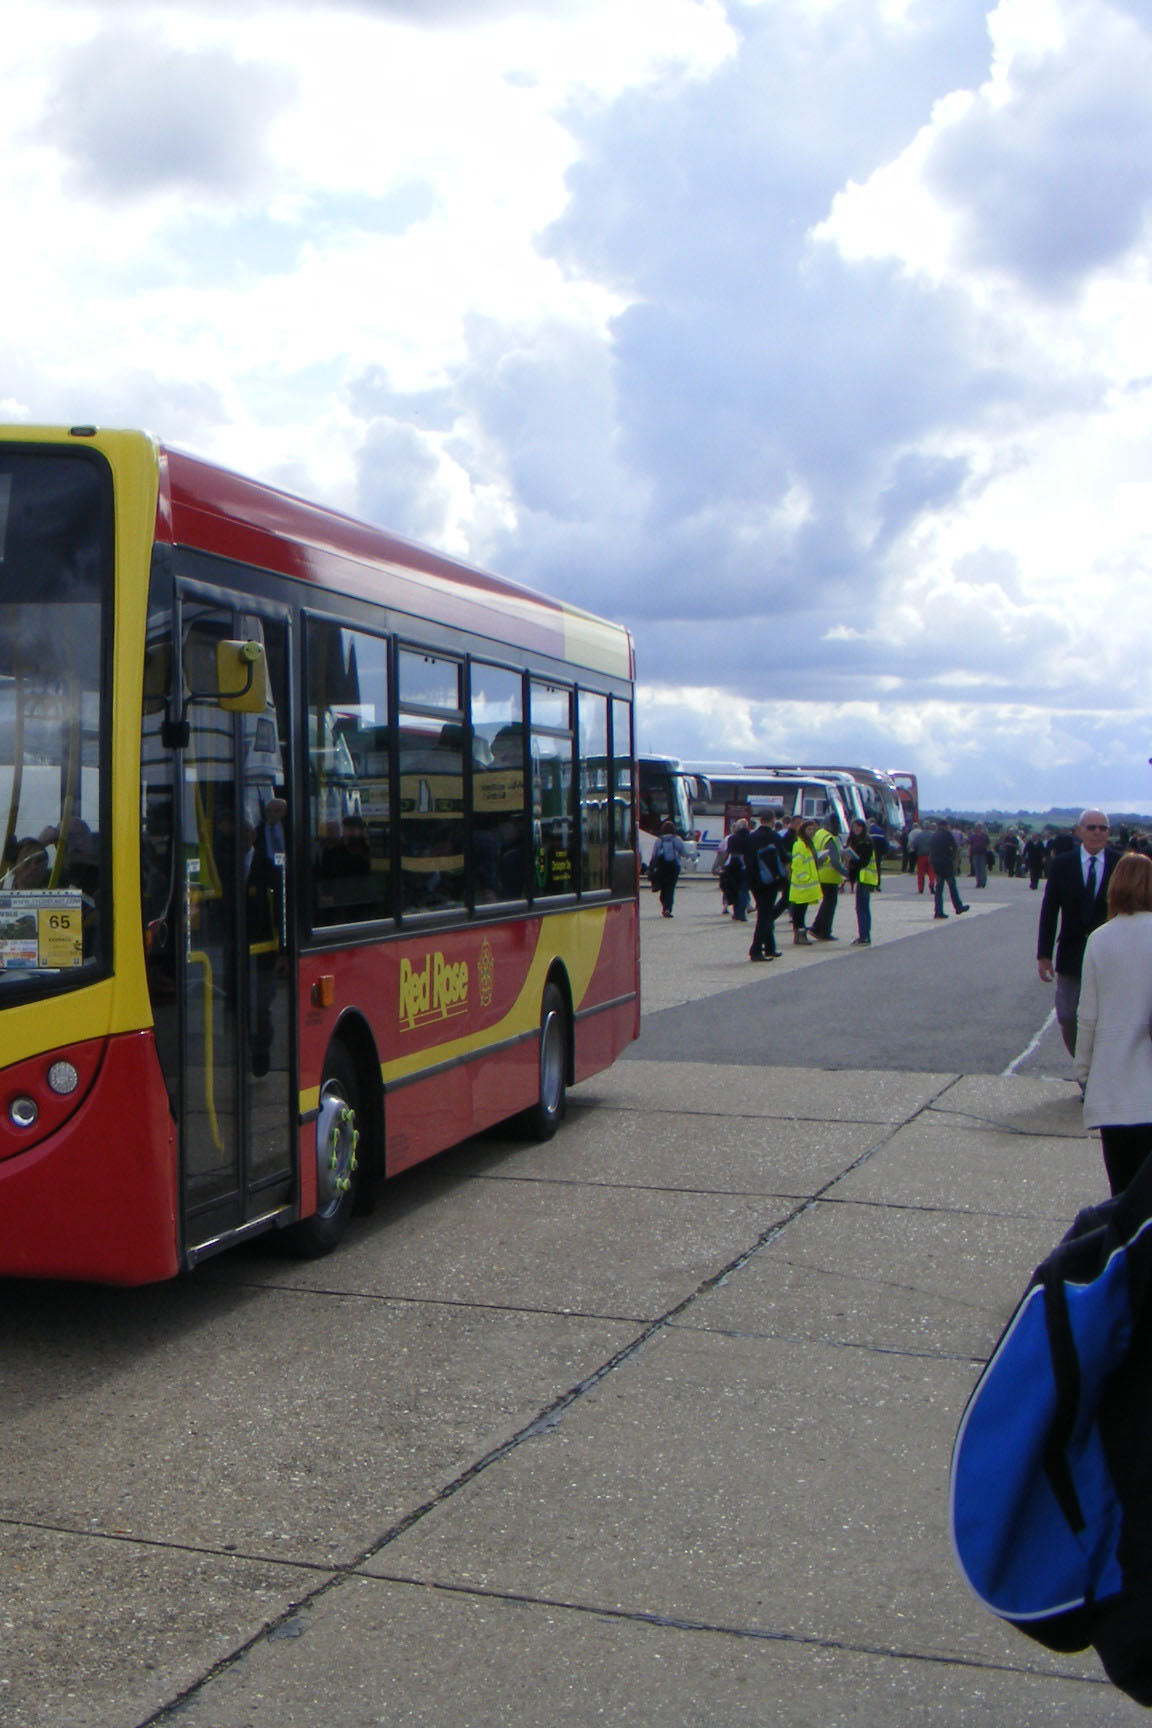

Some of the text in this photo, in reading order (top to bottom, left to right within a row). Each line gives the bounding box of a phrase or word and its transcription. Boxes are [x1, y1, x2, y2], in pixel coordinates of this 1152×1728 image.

[49, 915, 70, 929] 65
[399, 951, 469, 1029] Red Rose
